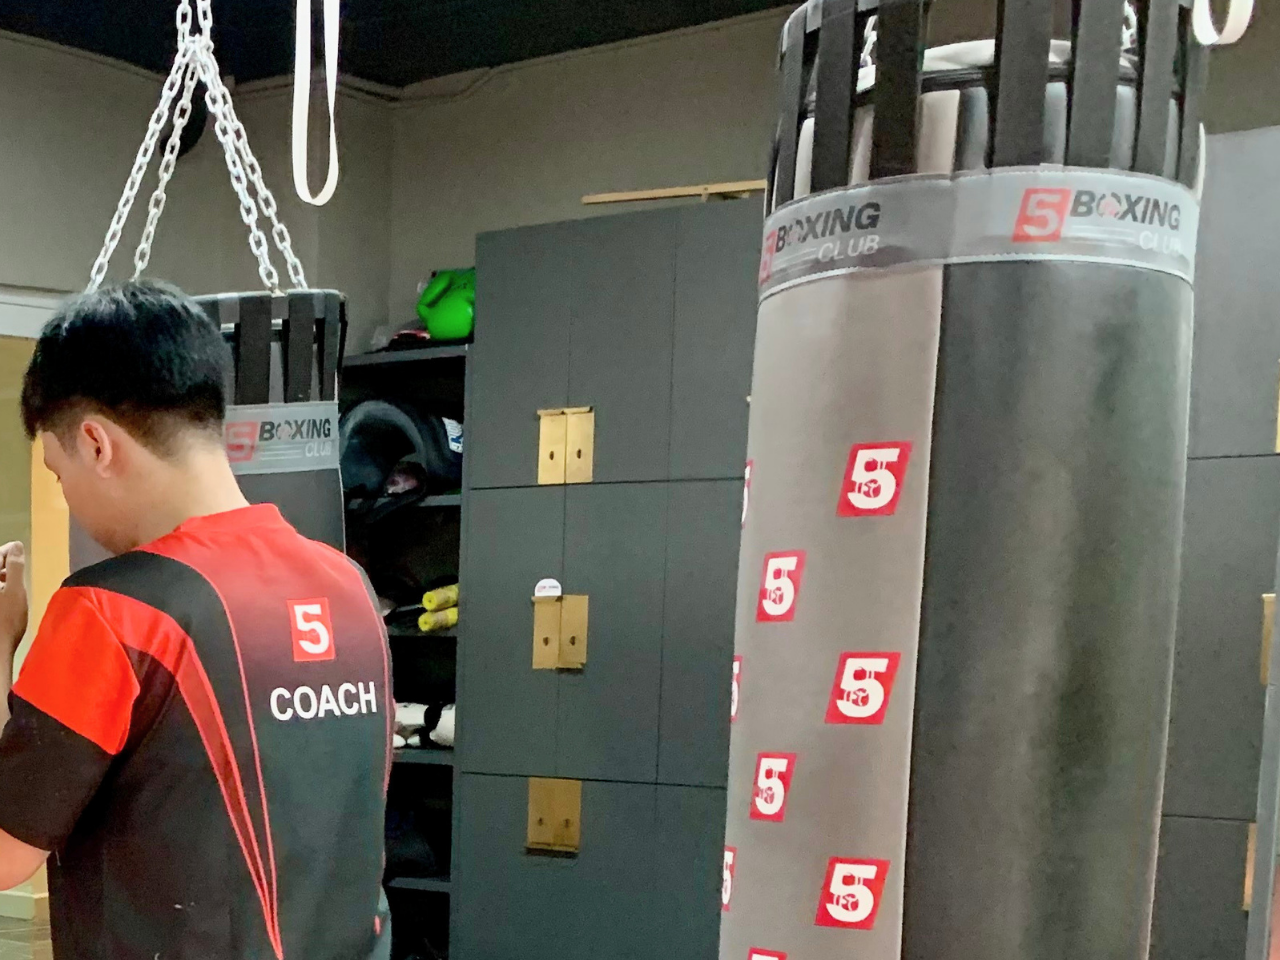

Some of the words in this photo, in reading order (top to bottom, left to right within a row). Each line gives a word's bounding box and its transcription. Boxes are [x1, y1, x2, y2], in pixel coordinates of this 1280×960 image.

[775, 202, 880, 253] BOXING
[1022, 192, 1061, 237] 5
[1070, 189, 1181, 231] BOXING
[818, 235, 880, 262] CLUB
[227, 424, 254, 460] 5
[259, 418, 331, 442] BOXING
[305, 441, 333, 458] CLUB
[848, 448, 900, 510] 5
[762, 556, 798, 616] 5
[294, 604, 329, 654] 5
[270, 681, 377, 721] COACH
[836, 657, 890, 719] 5
[754, 758, 788, 816] 5
[825, 864, 878, 923] 5
